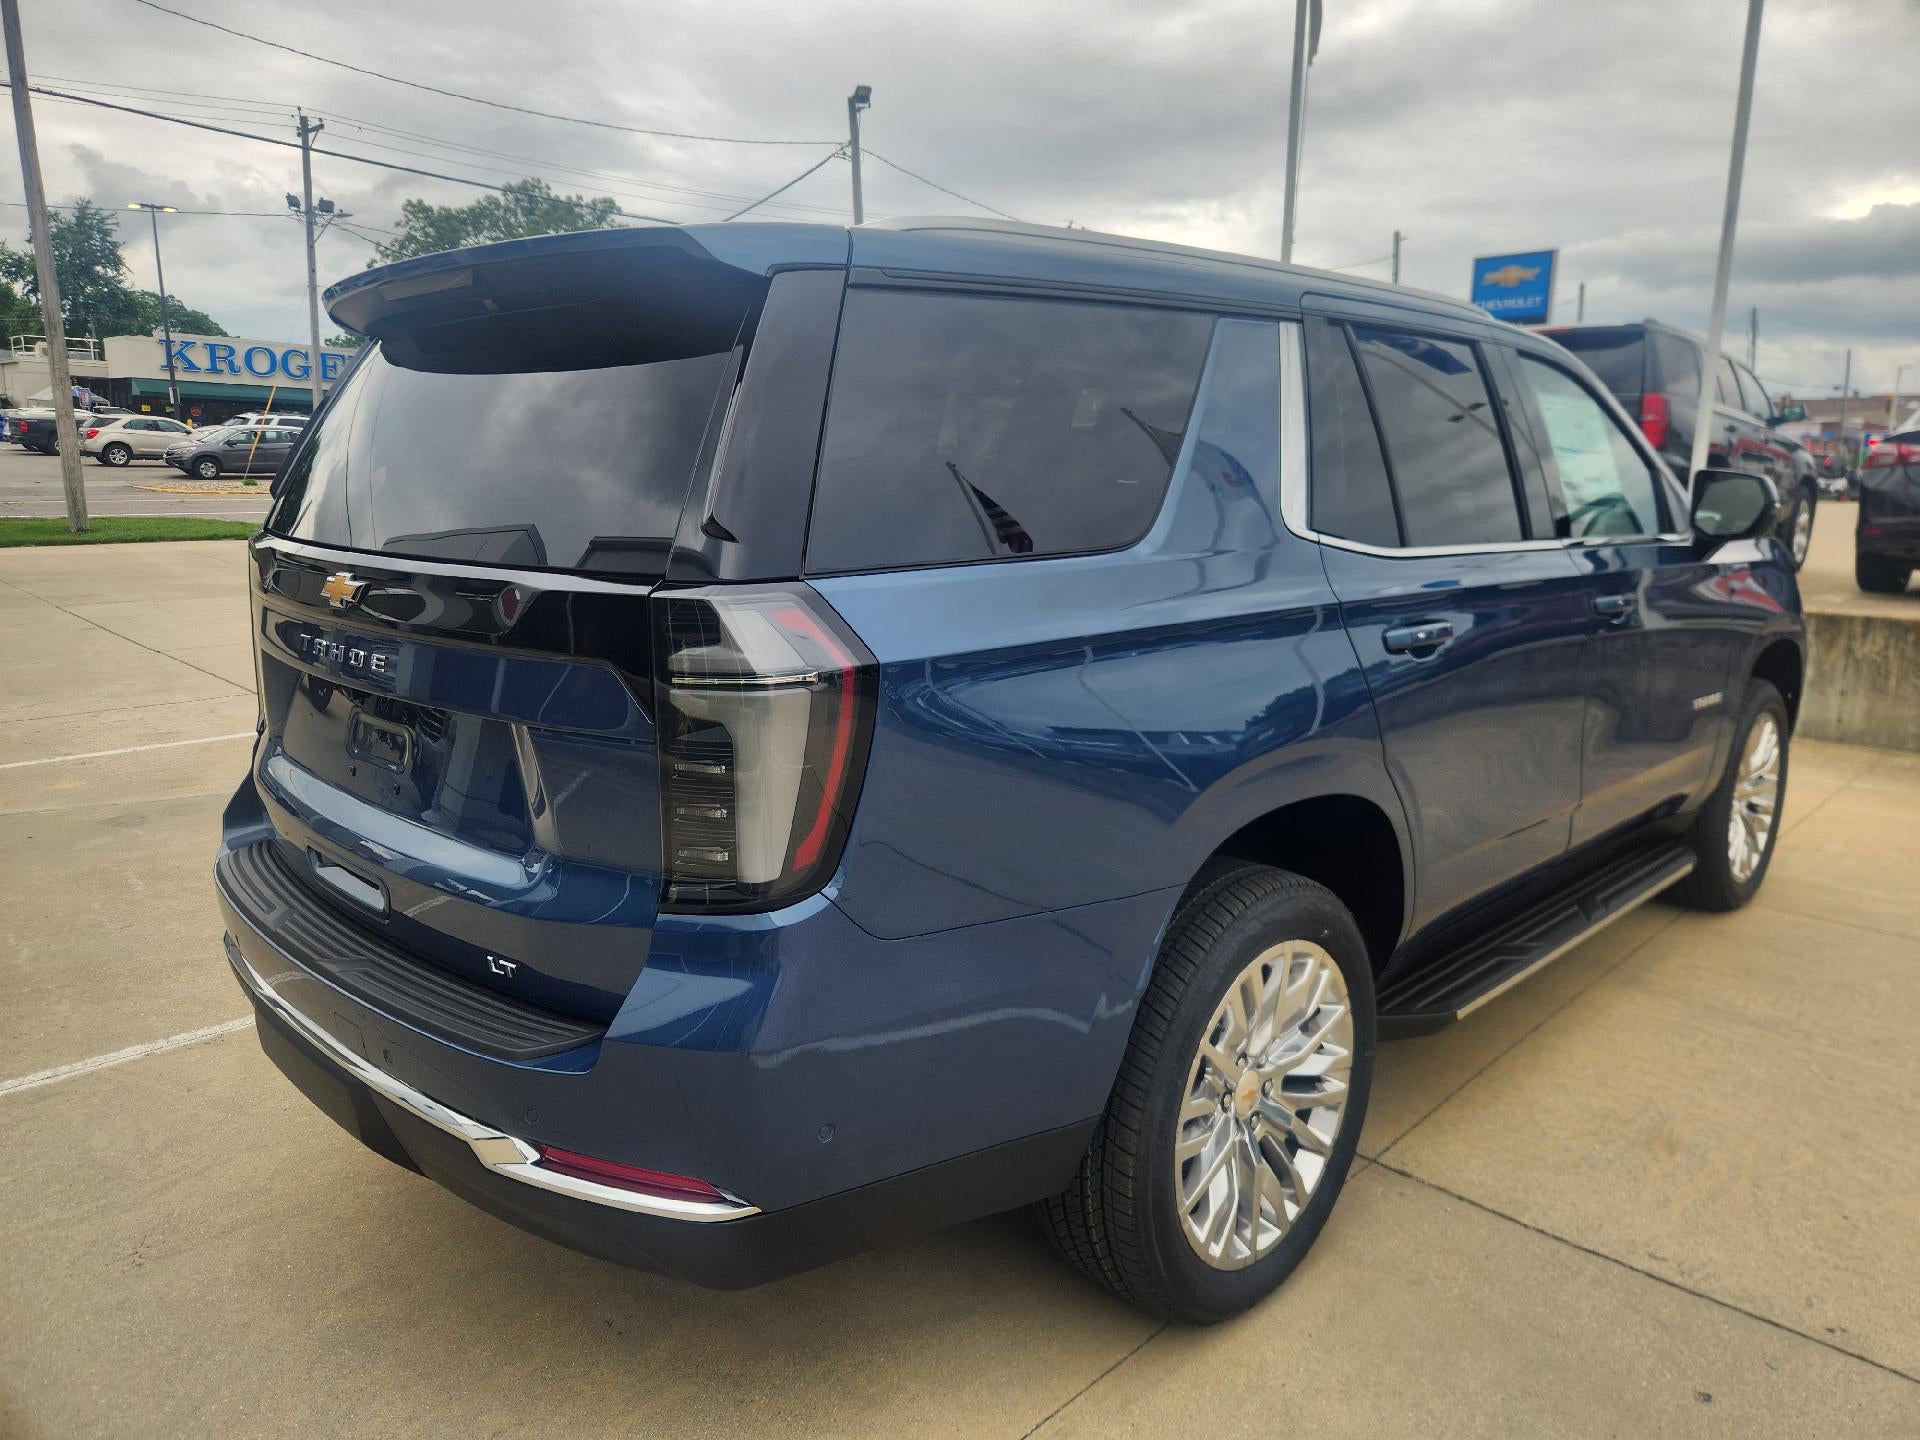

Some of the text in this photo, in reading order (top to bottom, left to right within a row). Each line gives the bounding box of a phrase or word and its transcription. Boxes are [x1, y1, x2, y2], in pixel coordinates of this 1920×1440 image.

[158, 338, 353, 381] KROGE
[300, 633, 387, 673] TAHOE
[486, 955, 517, 978] LT
